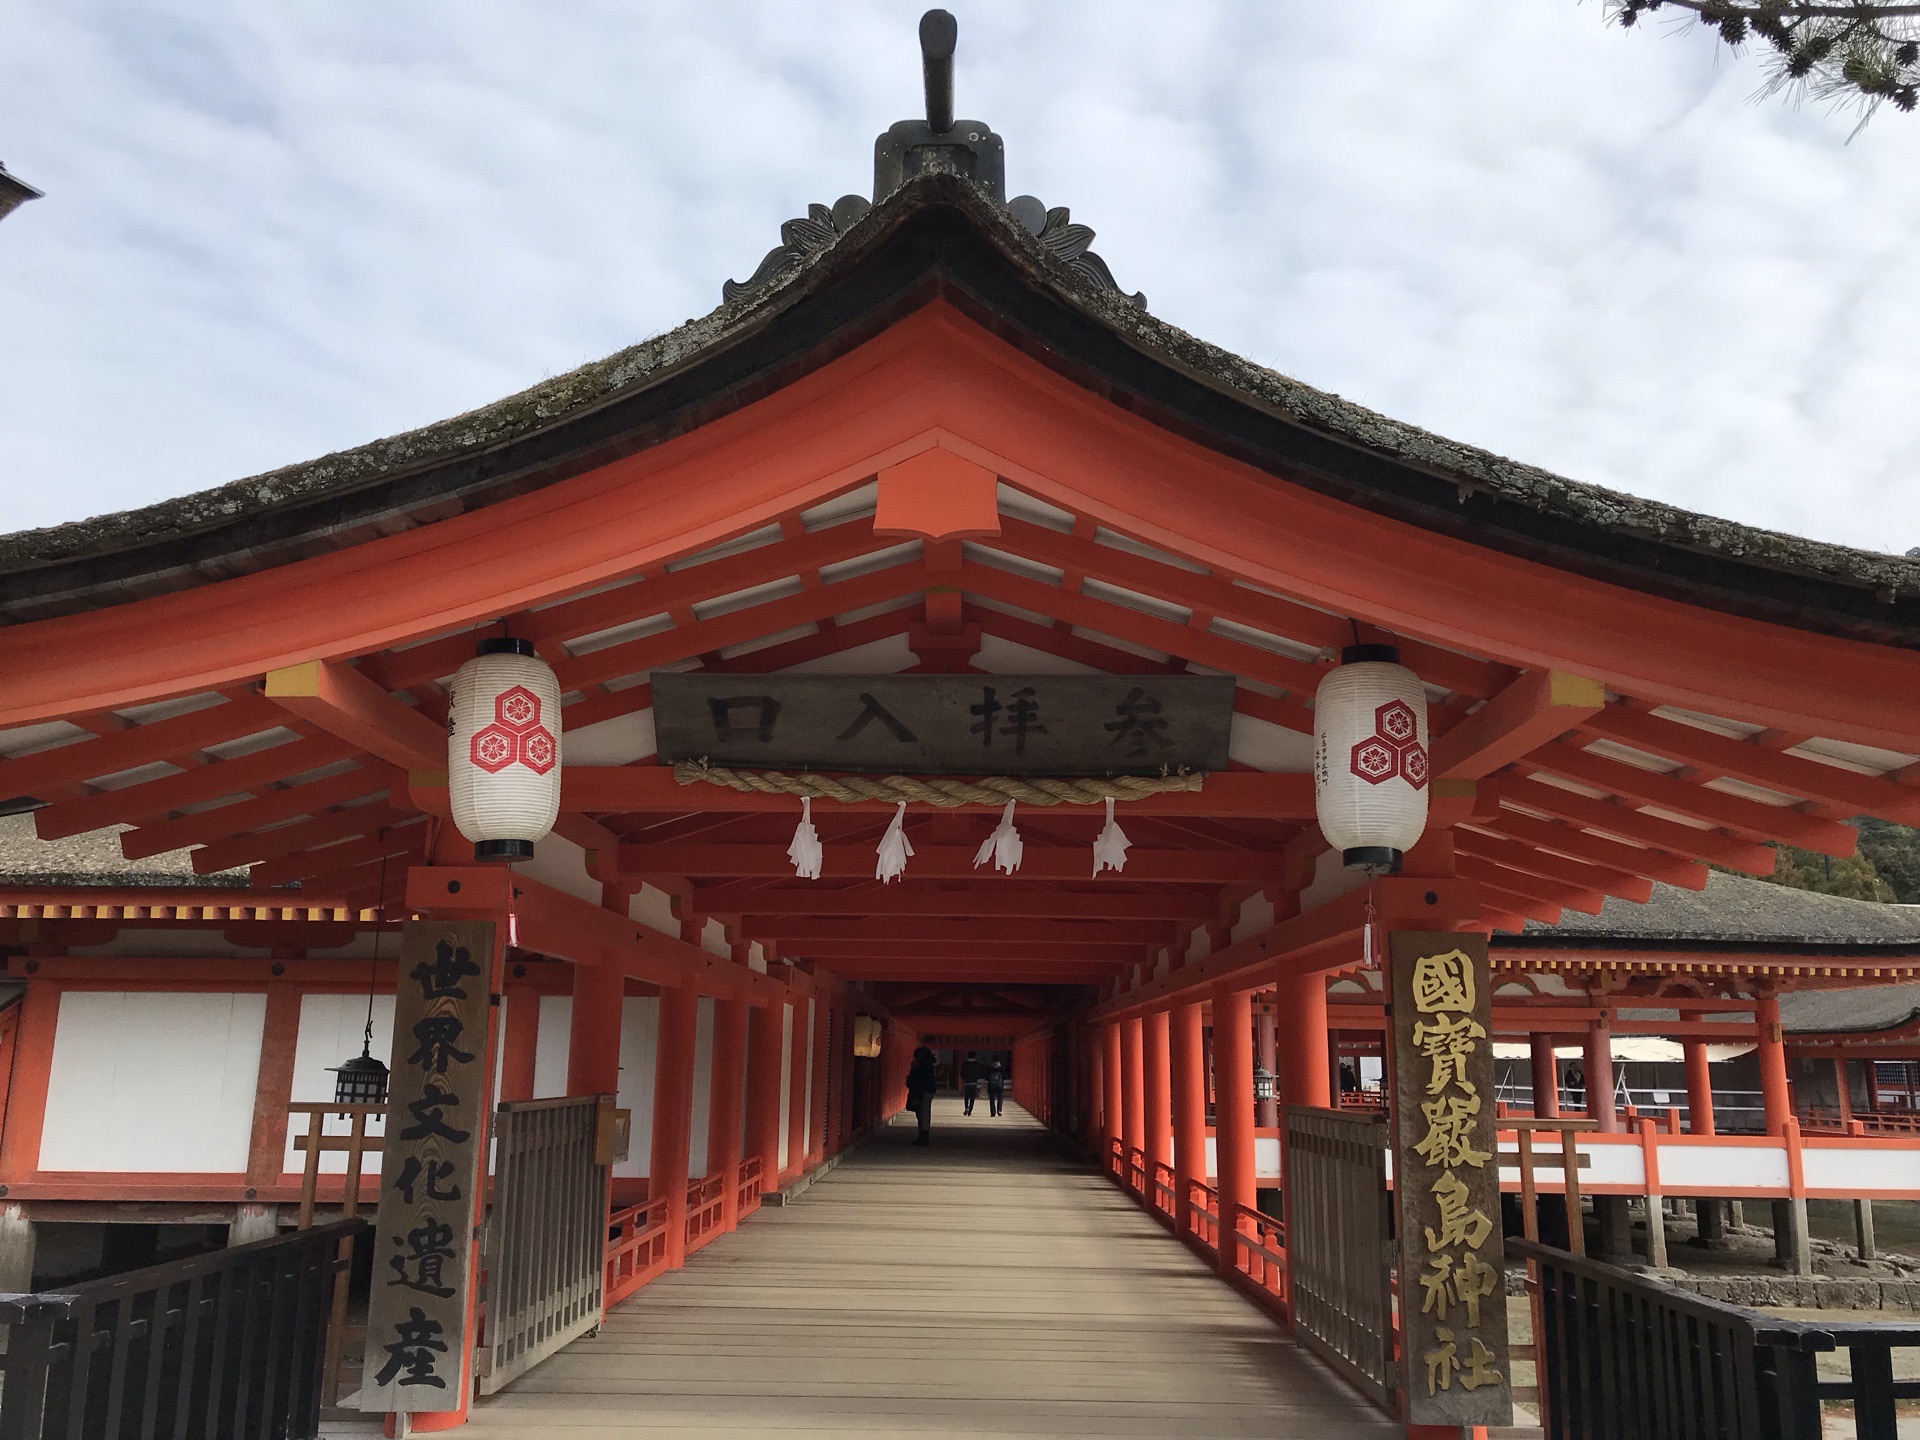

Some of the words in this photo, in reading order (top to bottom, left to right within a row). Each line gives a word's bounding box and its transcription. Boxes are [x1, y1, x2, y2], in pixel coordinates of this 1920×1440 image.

[375, 939, 481, 1389] 世界文化遺産
